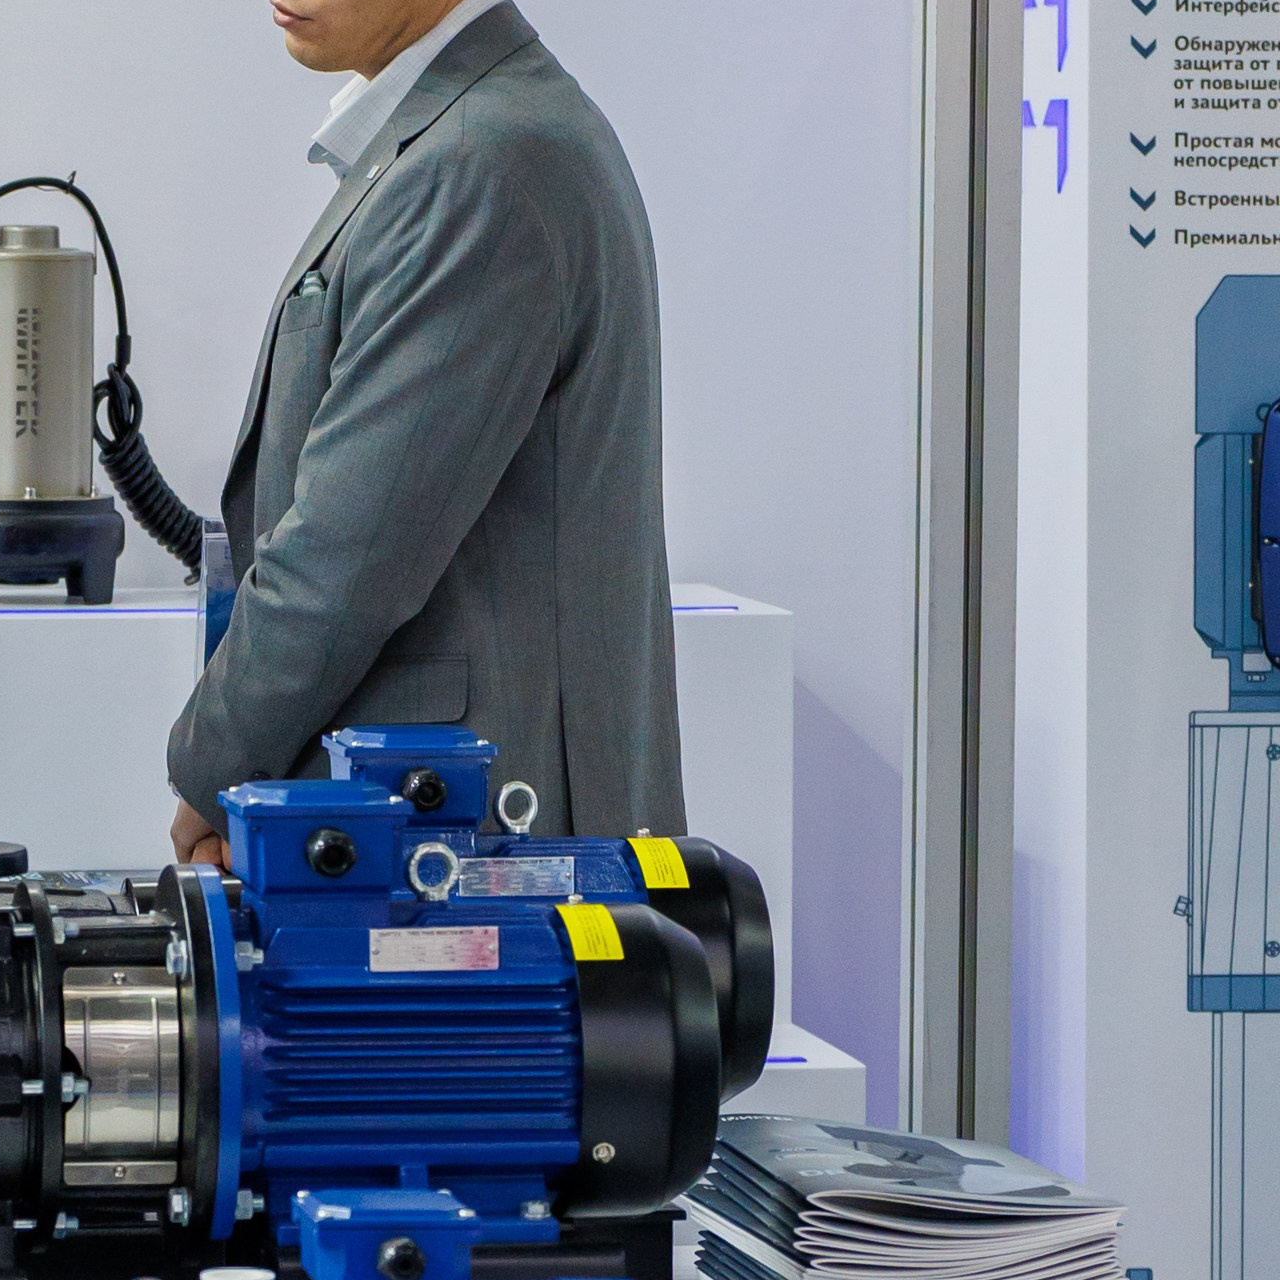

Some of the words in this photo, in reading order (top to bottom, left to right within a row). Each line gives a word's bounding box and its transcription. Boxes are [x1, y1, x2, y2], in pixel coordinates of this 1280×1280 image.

[1174, 35, 1280, 55] Обнаружен
[1174, 58, 1245, 73] защита
[1249, 59, 1271, 71] от
[1173, 78, 1195, 90] от
[1200, 78, 1280, 91] повыше
[1174, 98, 1185, 109] и
[1191, 98, 1262, 113] защита
[1267, 98, 1280, 110] о
[1174, 132, 1254, 152] Простая
[1174, 155, 1280, 171] непосредст
[1174, 189, 1280, 210] Встроенны
[1174, 228, 1280, 248] Премиальн
